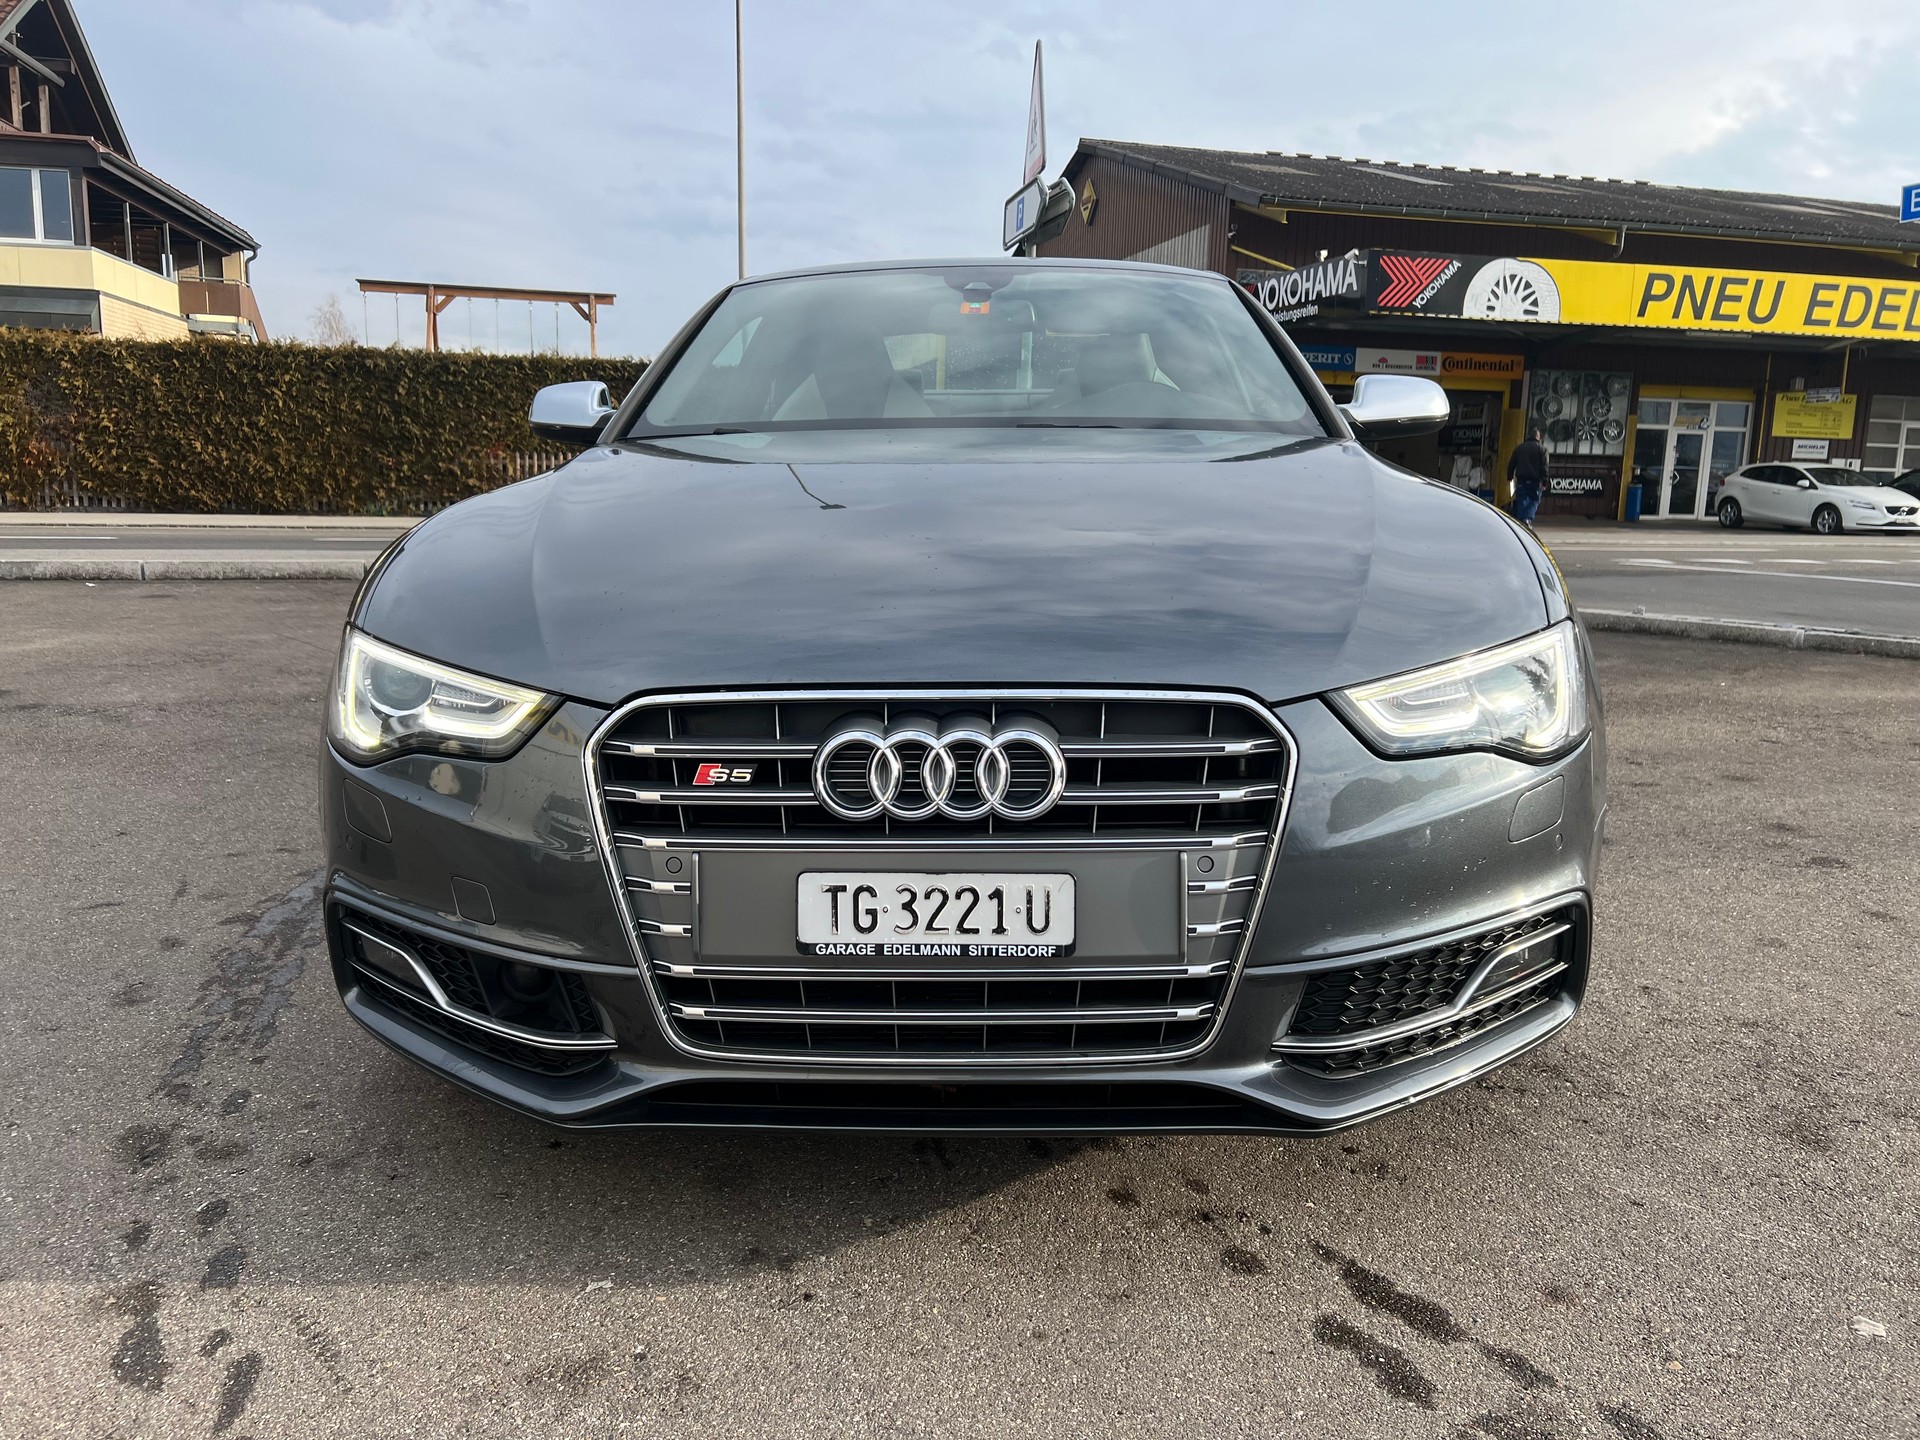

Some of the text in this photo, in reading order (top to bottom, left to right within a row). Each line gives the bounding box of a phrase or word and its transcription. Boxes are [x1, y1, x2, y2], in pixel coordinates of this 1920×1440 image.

[1258, 259, 1358, 311] YOKOHAMA
[1412, 259, 1462, 309] YOKOHAMA
[1636, 272, 1920, 332] PNEU EDEL
[1271, 303, 1319, 323] leistungsreifen
[1441, 356, 1515, 372] Continental
[1549, 478, 1603, 491] YOKOHAMA
[707, 768, 753, 782] S5
[815, 943, 1057, 957] GARAGE EDELMANN SITTERDORF
